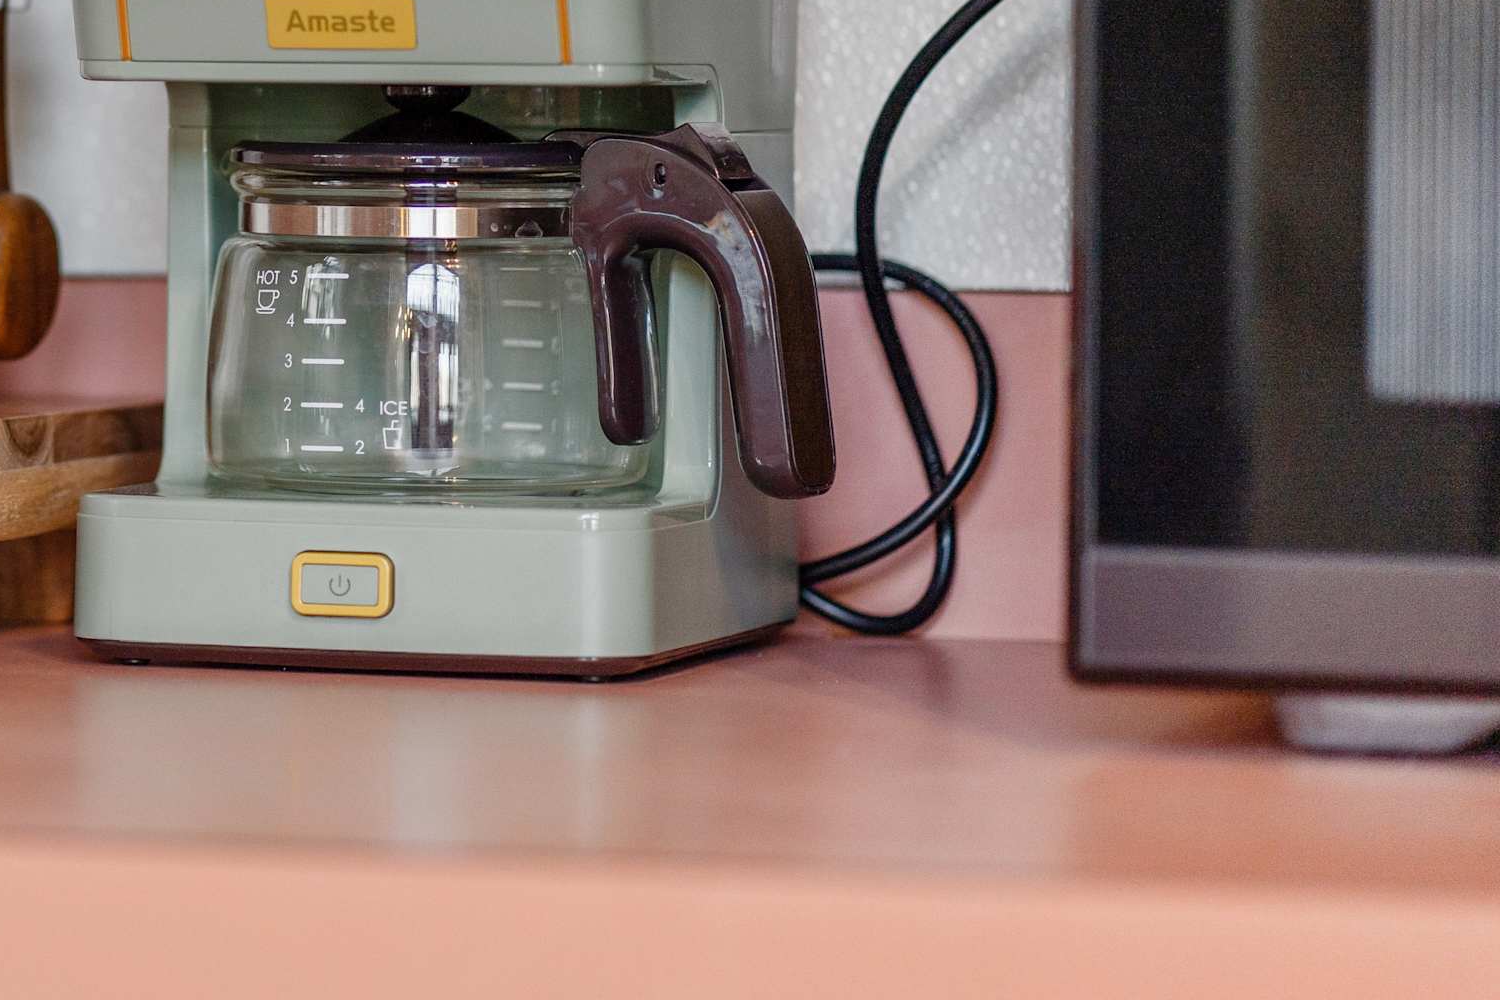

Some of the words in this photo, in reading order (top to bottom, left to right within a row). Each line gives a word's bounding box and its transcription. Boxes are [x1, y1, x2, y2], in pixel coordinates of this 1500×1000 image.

[286, 9, 396, 33] Amaste
[256, 270, 280, 285] HOT
[288, 270, 299, 285] 5
[286, 313, 296, 328] 4
[283, 353, 293, 369] 3
[283, 397, 292, 412] 2
[355, 399, 365, 413] 4
[379, 401, 408, 416] ICE
[284, 438, 291, 453] 1
[355, 441, 365, 455] 2
